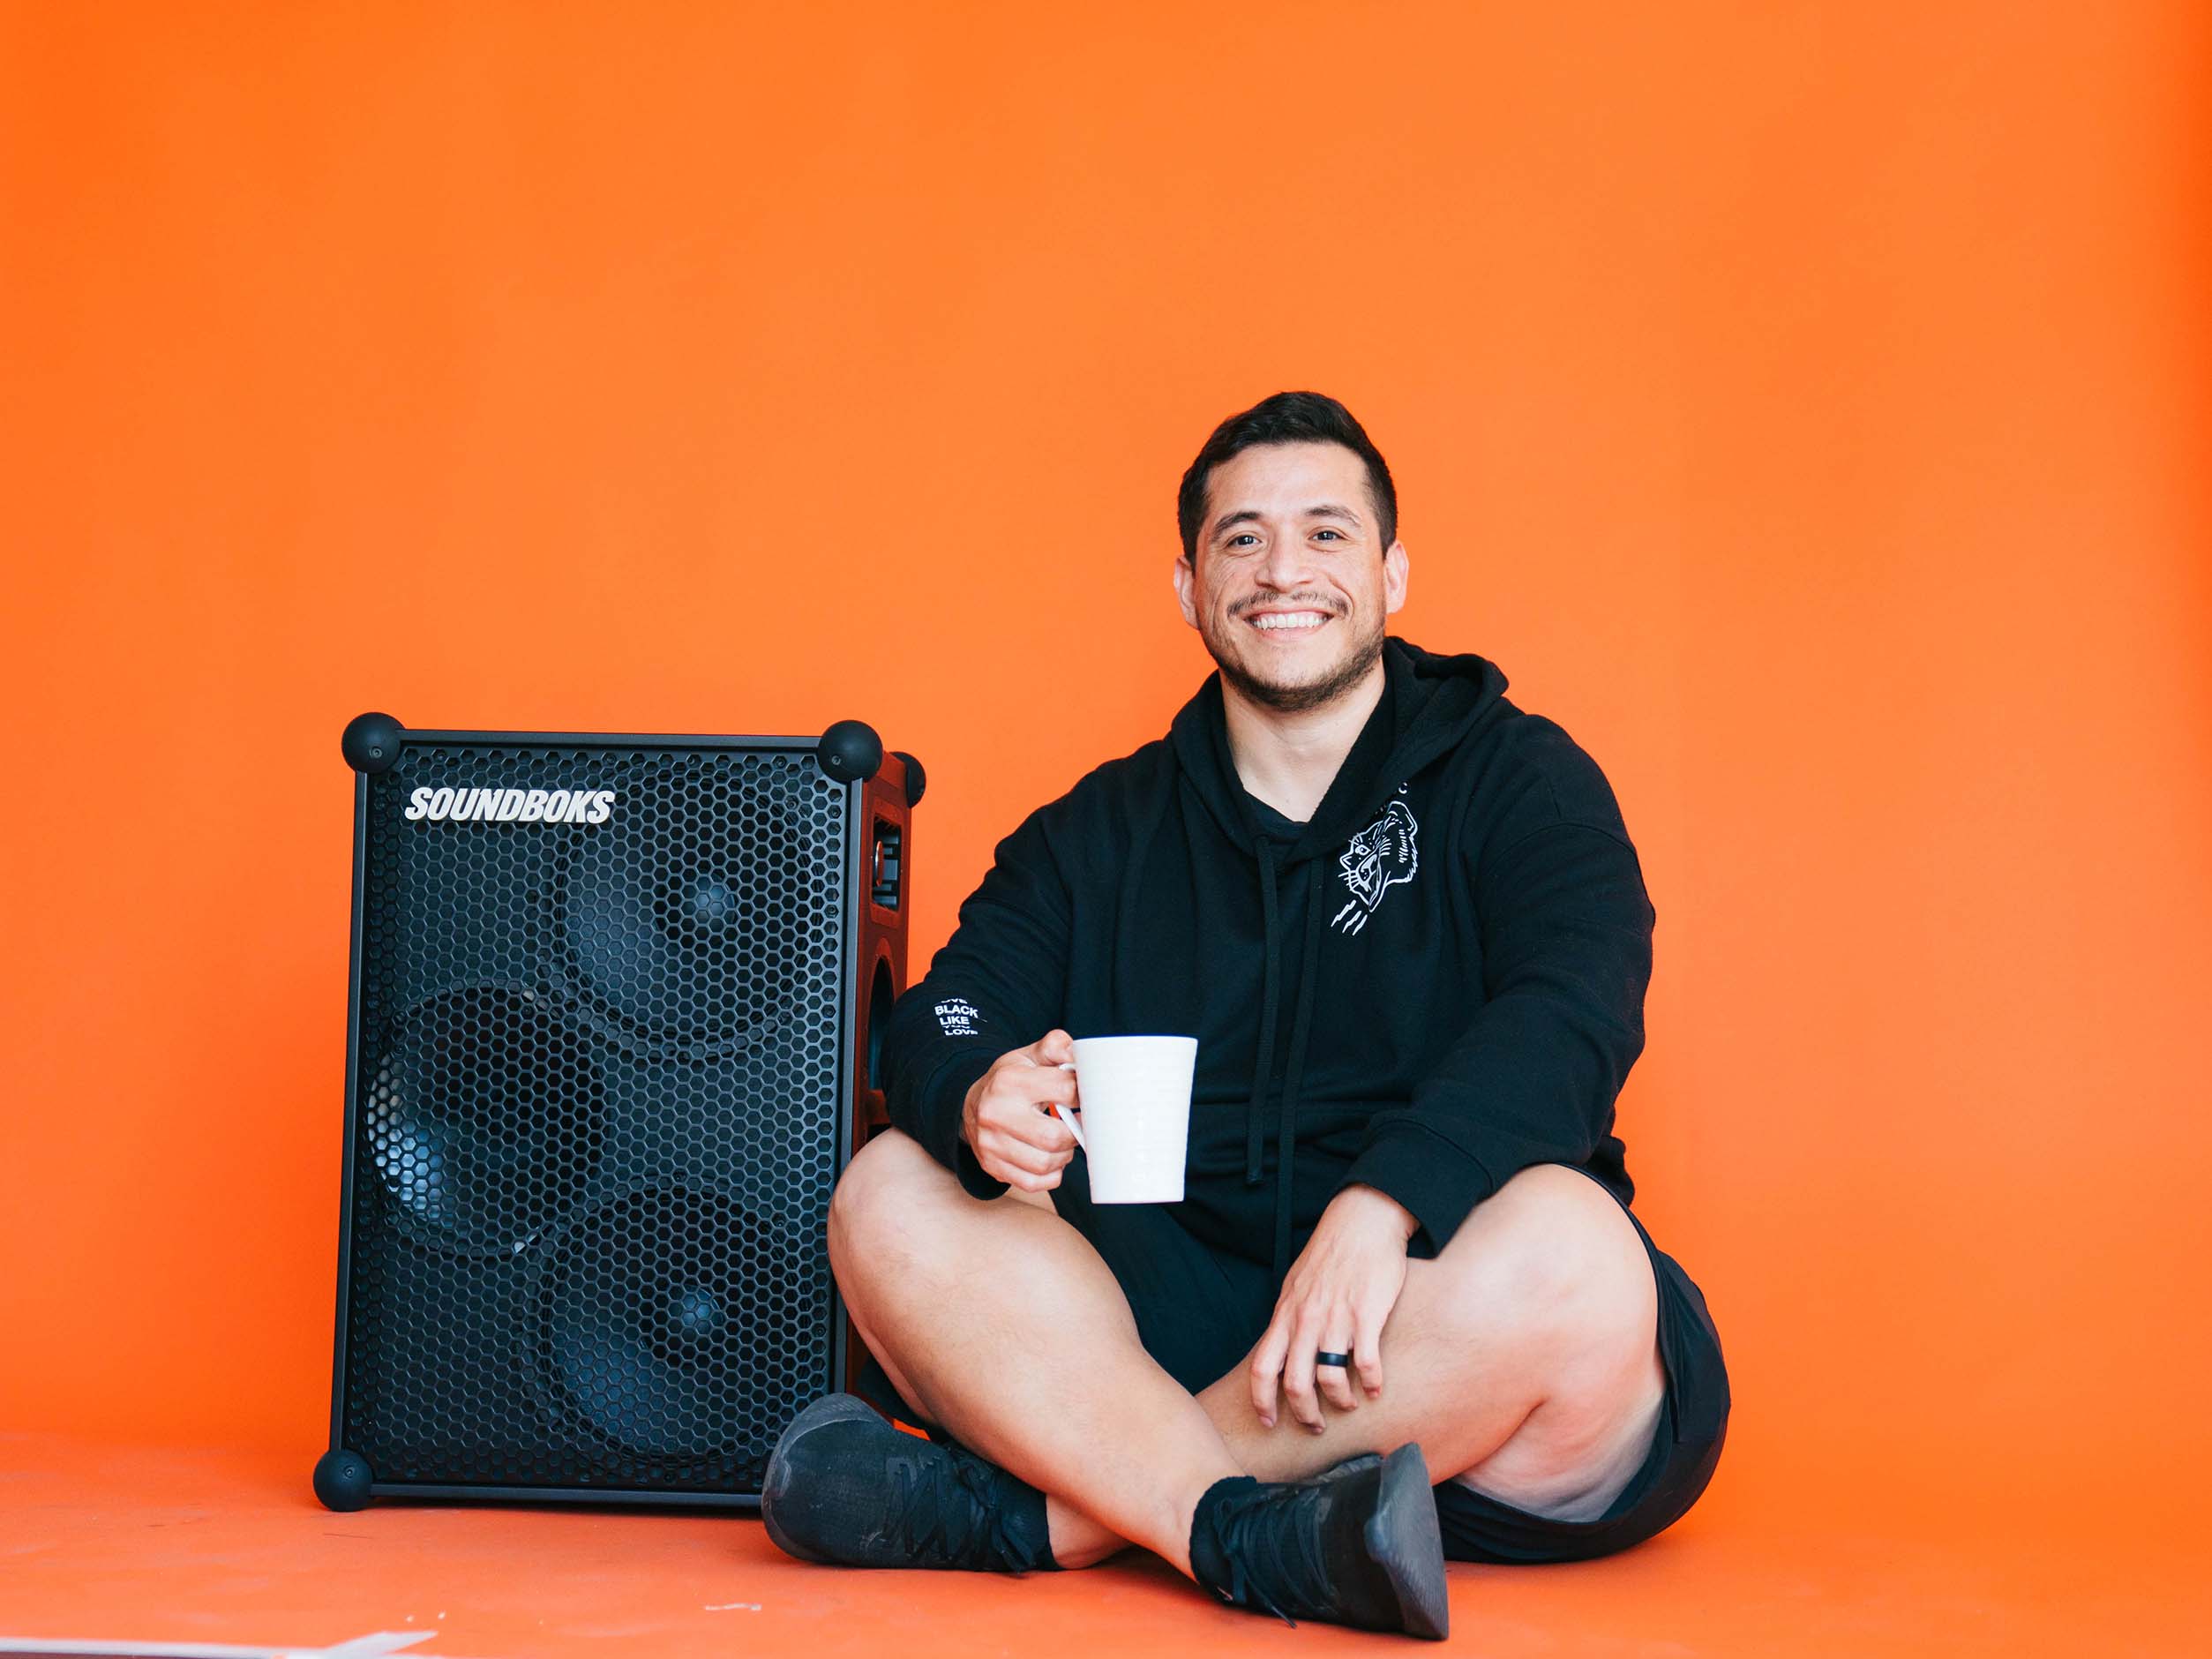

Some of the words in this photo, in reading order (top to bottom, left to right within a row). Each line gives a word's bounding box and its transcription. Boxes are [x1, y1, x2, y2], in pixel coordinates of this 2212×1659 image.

[405, 787, 615, 824] SOUNDBOKS
[934, 1004, 979, 1018] BLACK
[939, 1016, 970, 1025] LIKE
